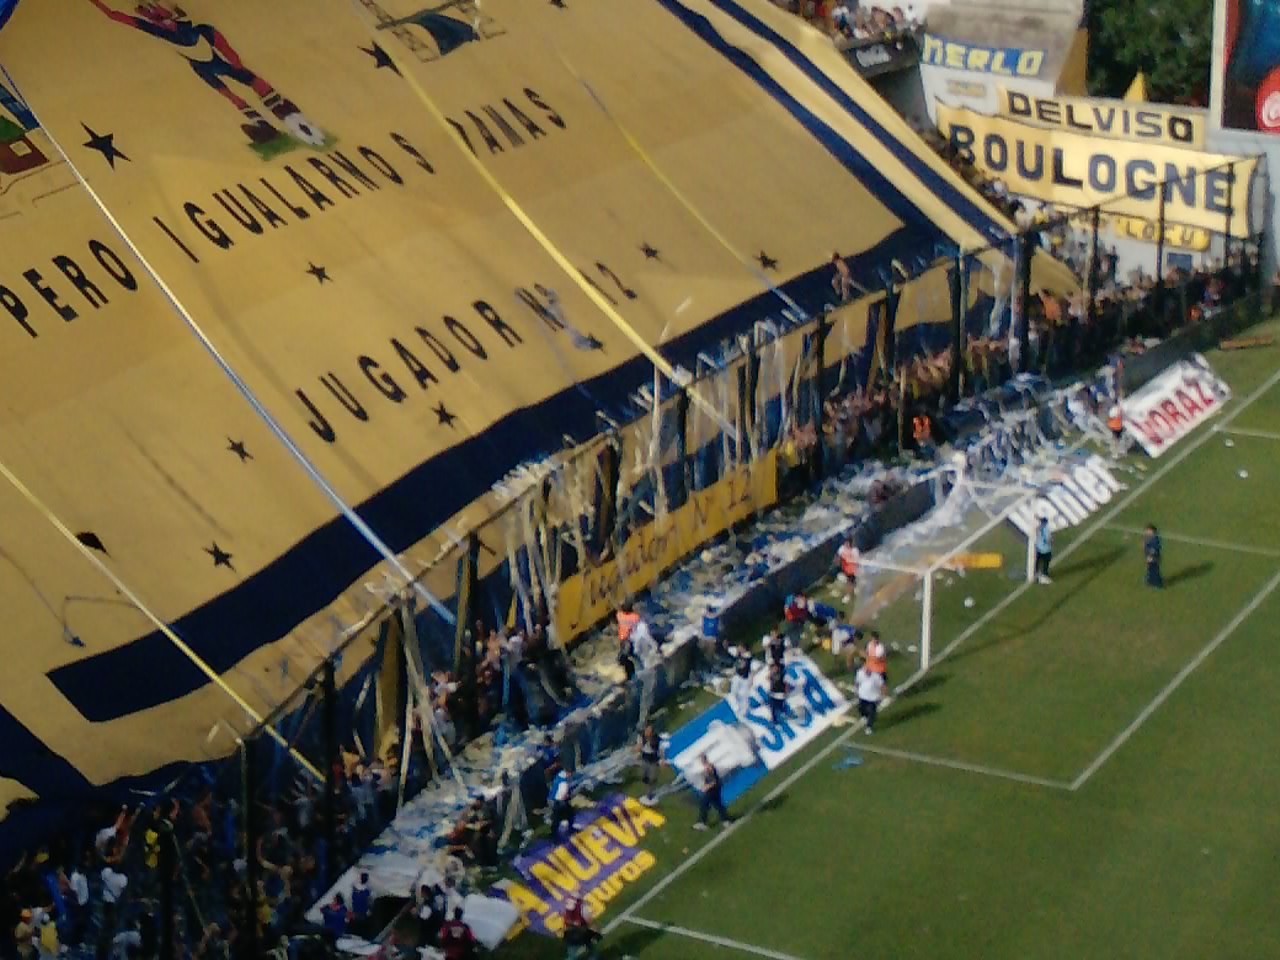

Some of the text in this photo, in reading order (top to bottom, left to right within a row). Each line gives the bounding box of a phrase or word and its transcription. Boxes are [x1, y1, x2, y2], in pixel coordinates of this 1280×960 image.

[948, 123, 1238, 217] BOULOGNE
[295, 299, 524, 444] JUGADOR
[529, 795, 667, 902] NUEVA
